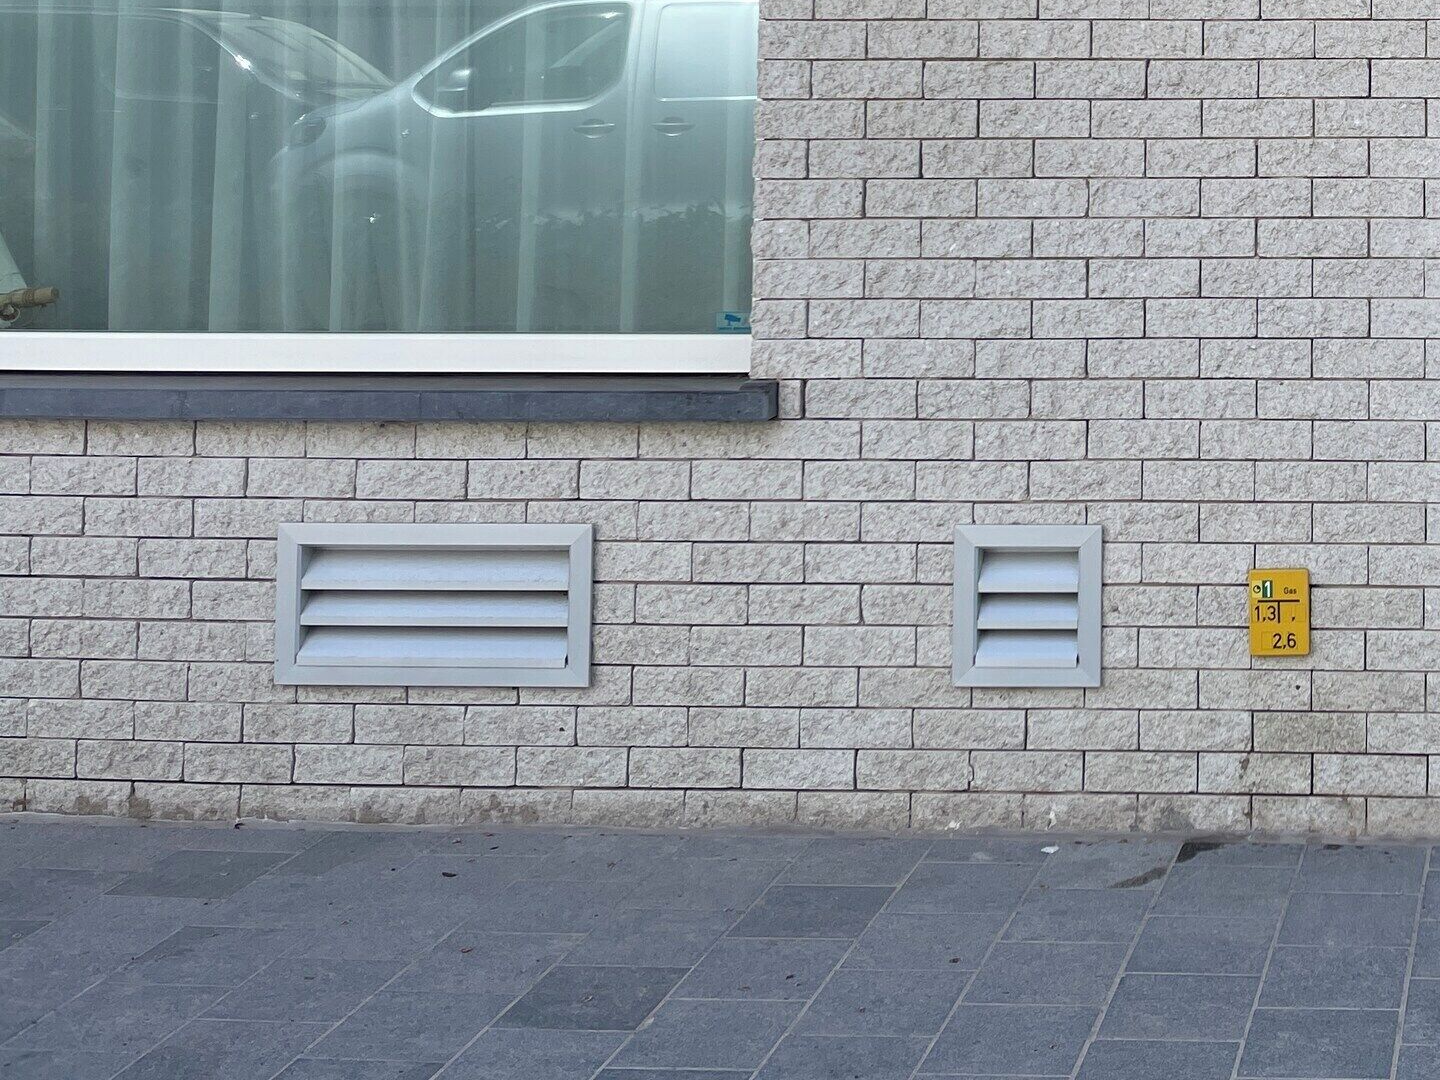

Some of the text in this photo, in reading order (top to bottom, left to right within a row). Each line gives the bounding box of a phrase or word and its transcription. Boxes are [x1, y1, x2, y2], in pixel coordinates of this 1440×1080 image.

[1283, 587, 1297, 595] Gas
[1254, 605, 1276, 622] 1,3
[1272, 632, 1297, 650] 2,6
